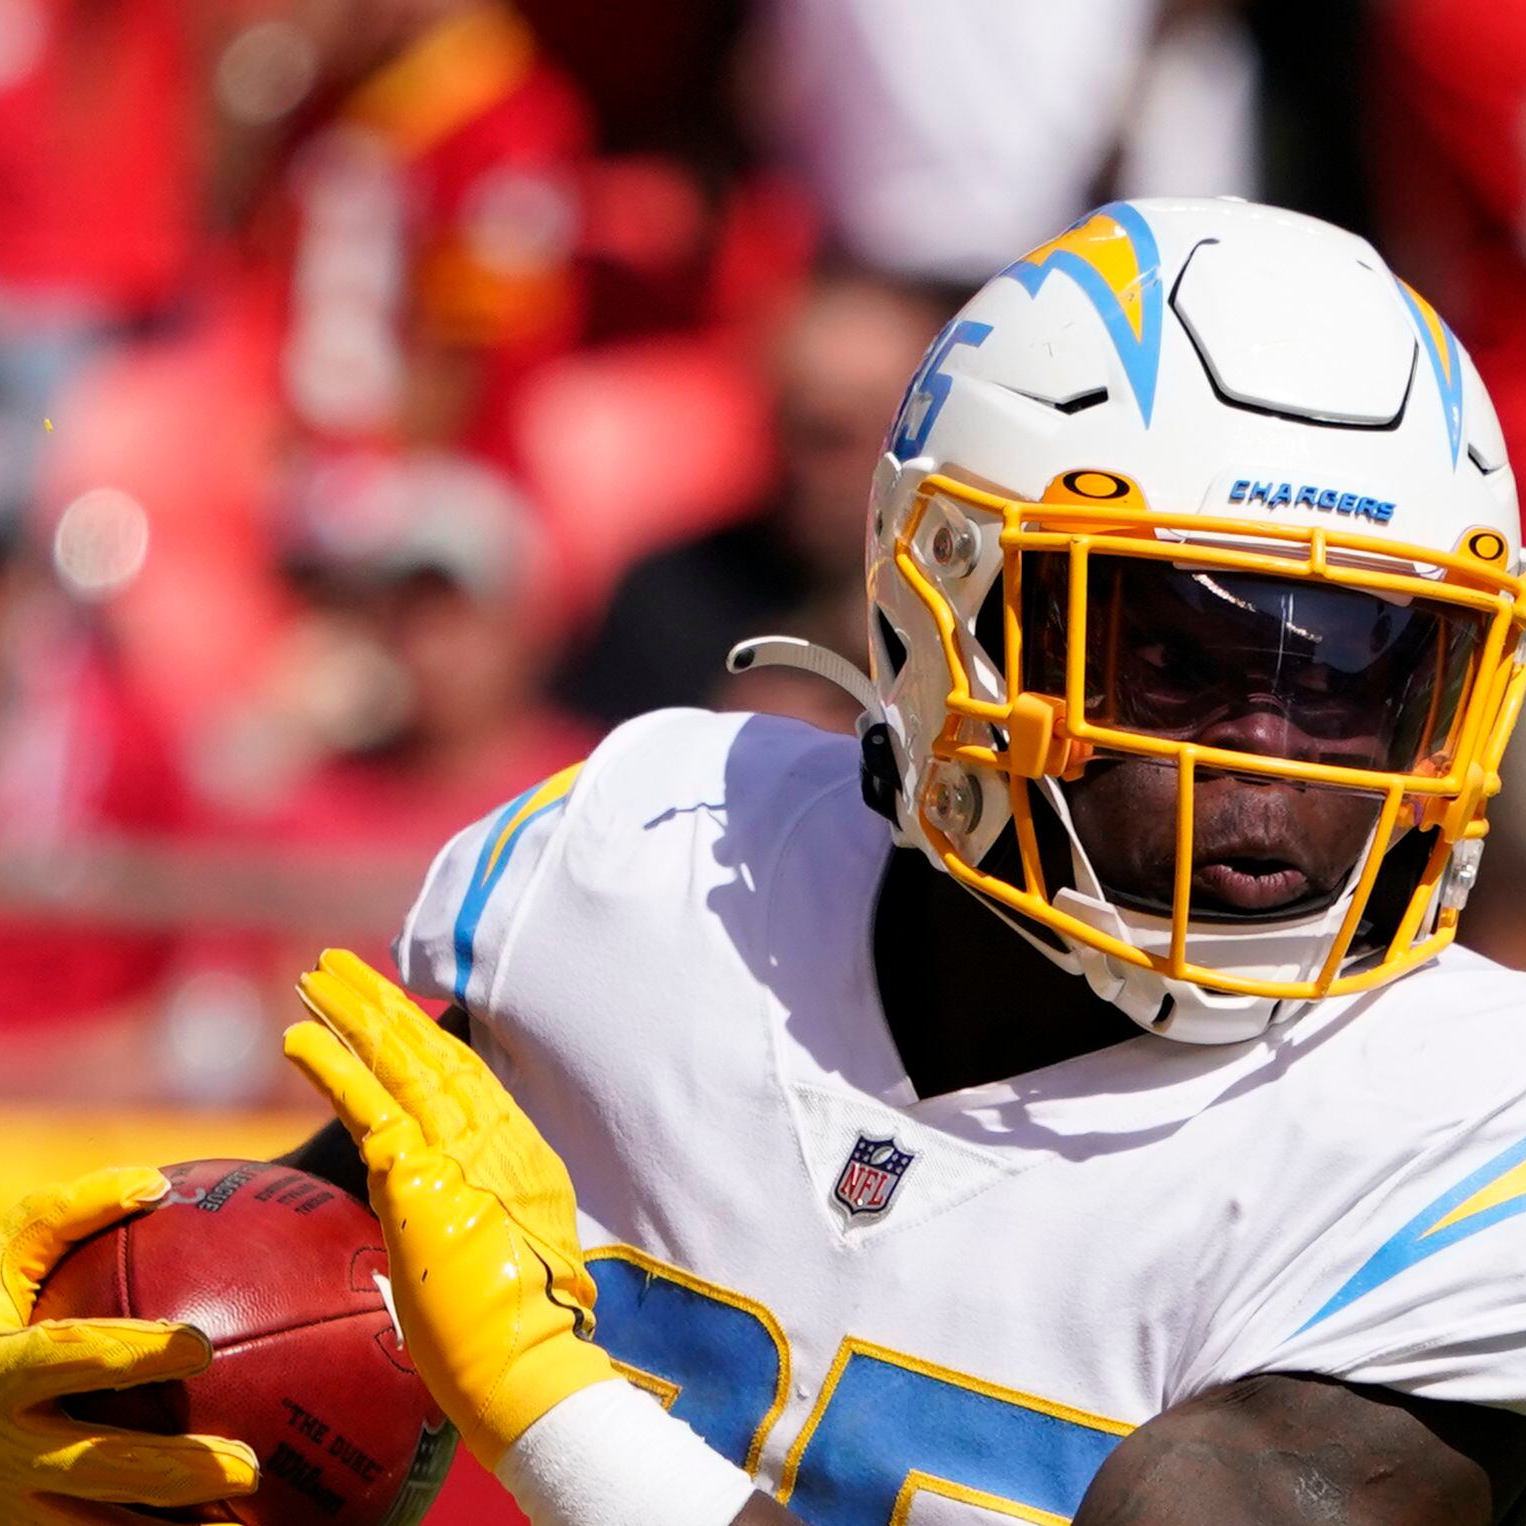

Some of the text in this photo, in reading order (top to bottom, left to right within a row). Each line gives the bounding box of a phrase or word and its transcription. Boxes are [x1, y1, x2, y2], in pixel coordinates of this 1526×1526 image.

[887, 318, 995, 462] 5
[1228, 479, 1397, 526] CHARGERS
[840, 1162, 889, 1207] NFL
